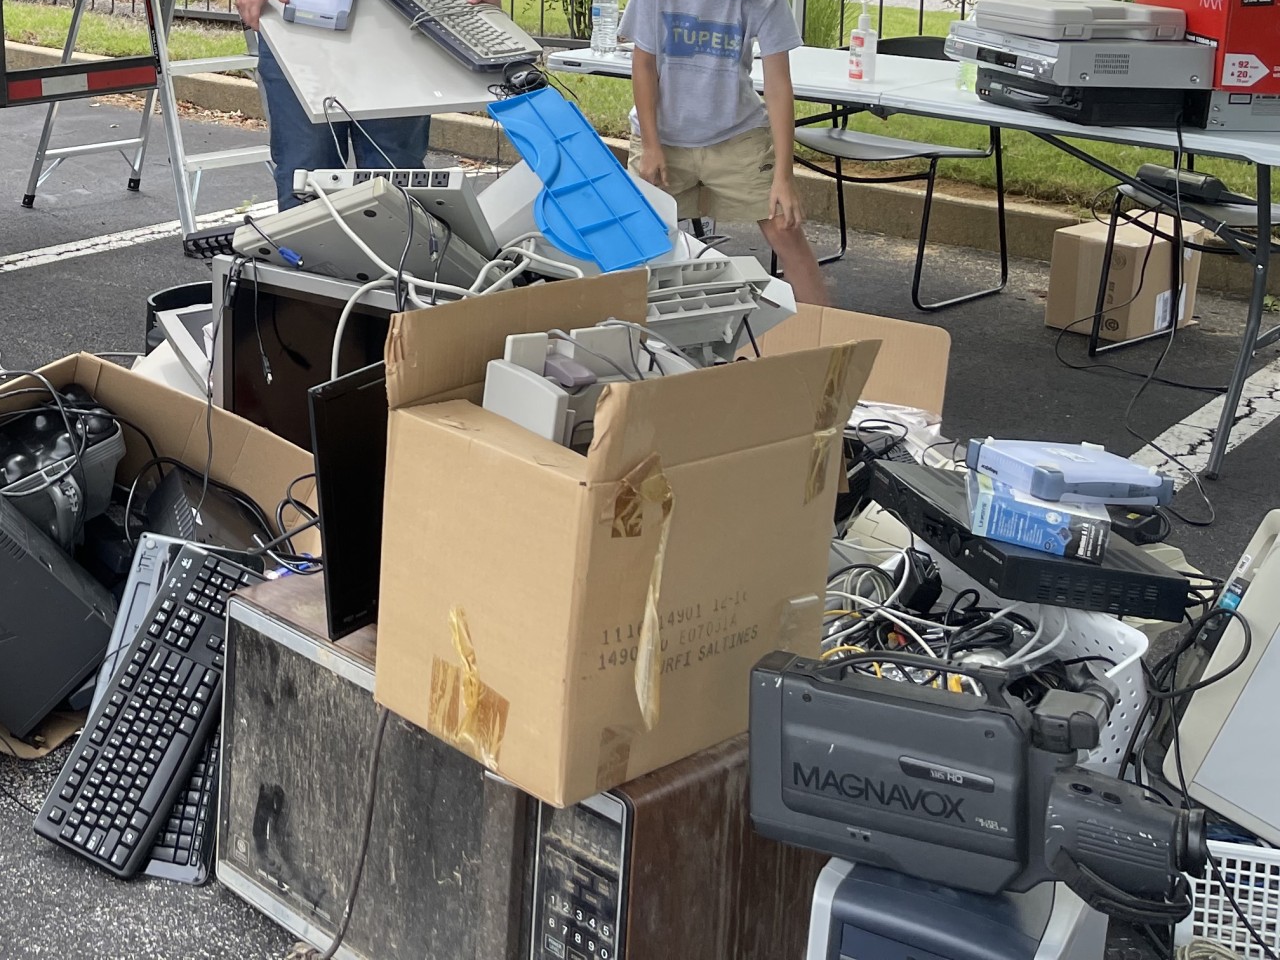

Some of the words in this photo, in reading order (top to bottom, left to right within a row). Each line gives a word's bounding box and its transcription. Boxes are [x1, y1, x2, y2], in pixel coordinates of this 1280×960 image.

[1236, 70, 1248, 78] 20
[1238, 61, 1250, 69] 92
[698, 624, 758, 661] SALTINES
[792, 761, 966, 823] MAGNAVOX
[947, 772, 964, 784] HQ
[562, 902, 569, 913] 2
[576, 910, 583, 921] 3
[589, 918, 596, 928] 4
[603, 925, 609, 936] 5
[548, 917, 555, 928] 6
[562, 925, 568, 935] 7
[574, 932, 581, 944] 8
[588, 940, 595, 951] 9
[600, 949, 608, 959] 0
